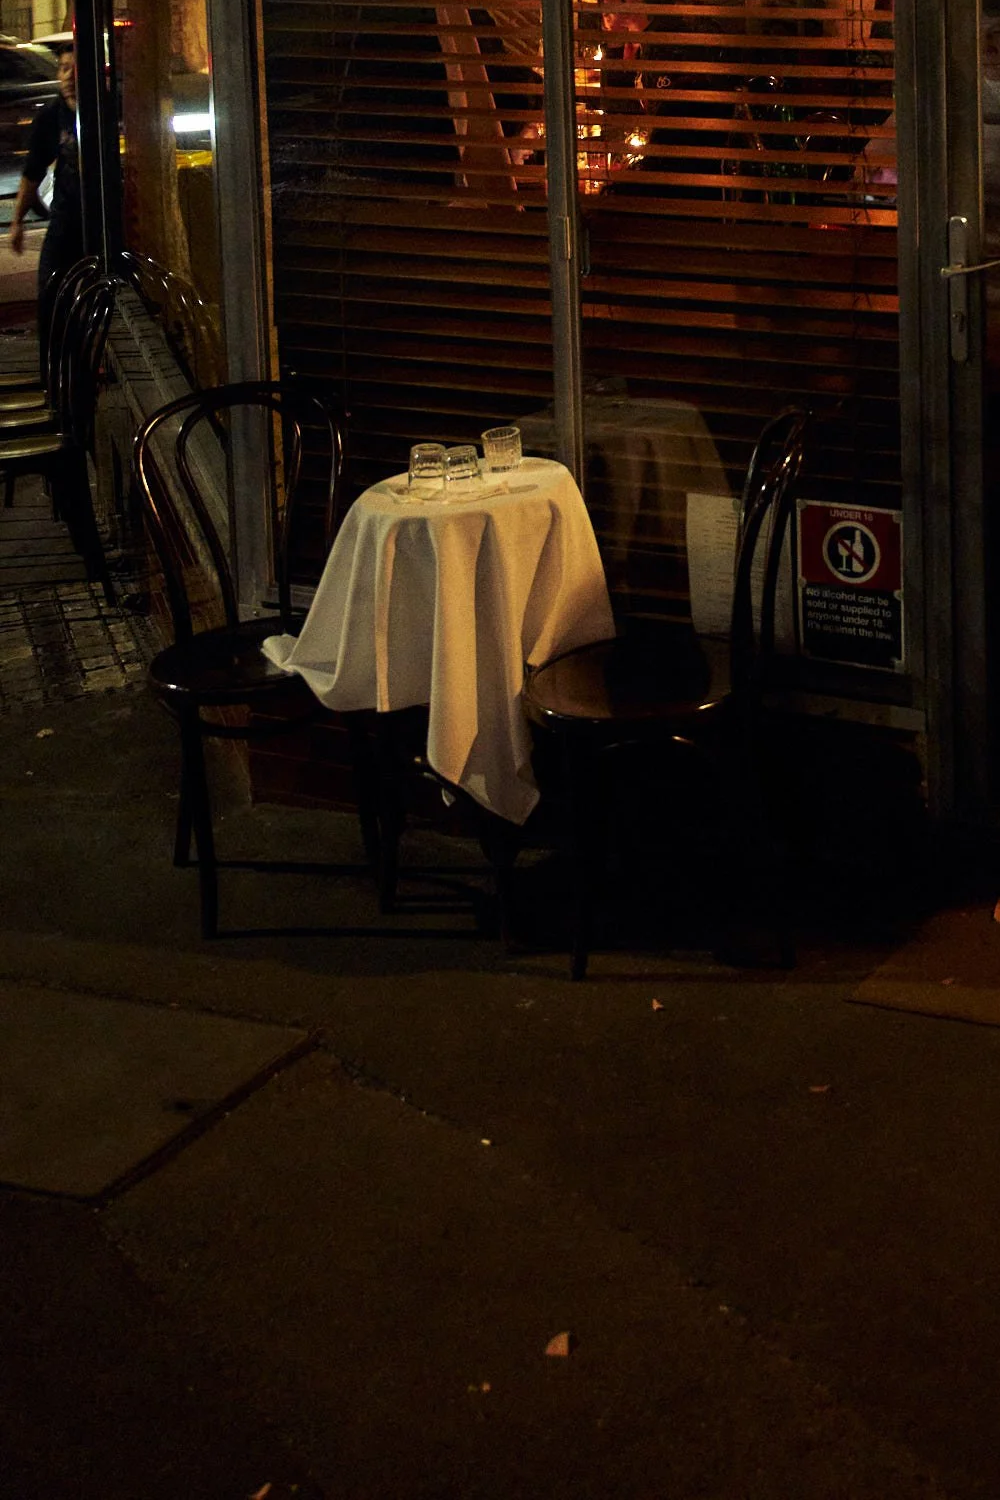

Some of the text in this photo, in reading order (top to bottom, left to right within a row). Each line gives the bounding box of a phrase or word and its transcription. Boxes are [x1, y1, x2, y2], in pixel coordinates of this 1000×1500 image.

[829, 509, 862, 522] UNDER
[806, 587, 889, 607] No alcohol can be
[806, 599, 827, 610] sold
[840, 603, 881, 618] supplied
[807, 612, 841, 624] anyone
[842, 613, 870, 626] under
[858, 627, 874, 639] the
